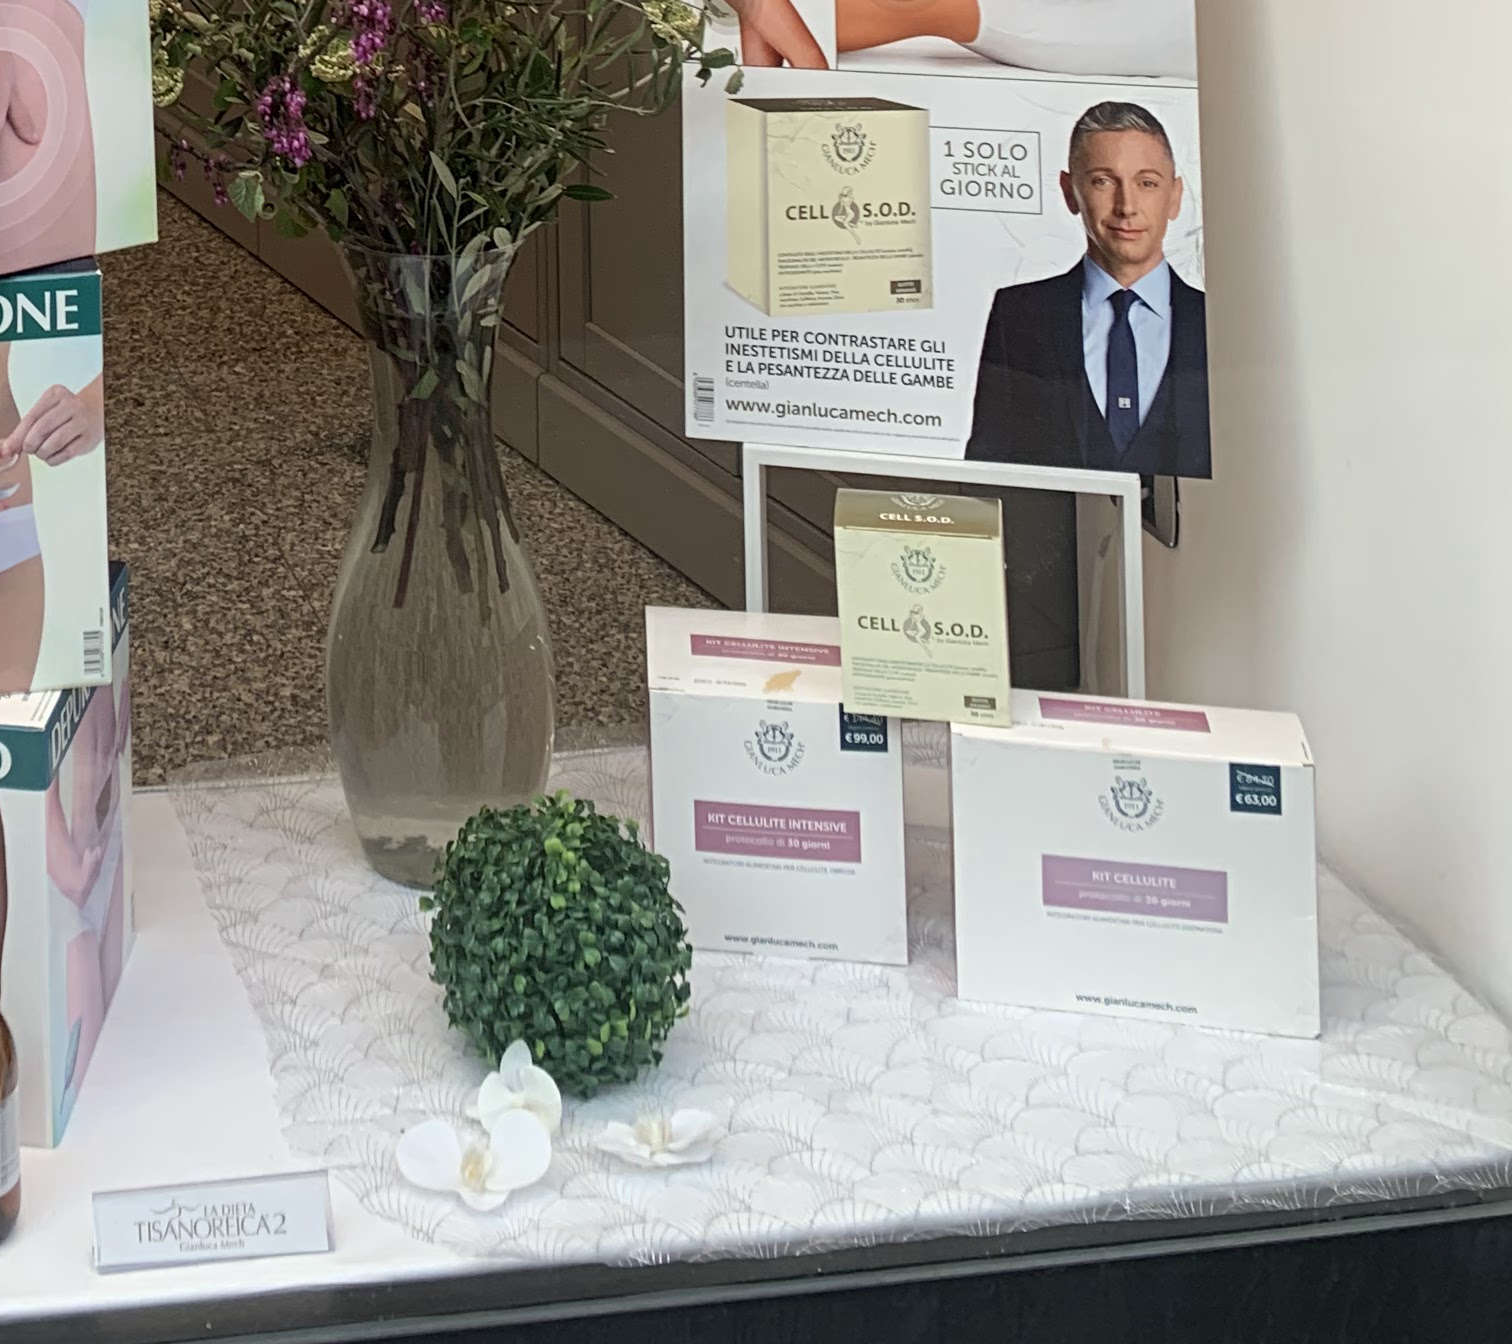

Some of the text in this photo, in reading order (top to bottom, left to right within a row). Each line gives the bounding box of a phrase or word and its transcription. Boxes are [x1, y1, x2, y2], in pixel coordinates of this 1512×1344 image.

[943, 141, 1028, 161] 1 SOLO
[952, 162, 1020, 179] STICK AL
[940, 179, 1034, 200] GIORNO
[786, 202, 916, 221] CELL S.O.D.
[725, 326, 945, 354] UTILE PER CONTRASTARE GLI
[725, 343, 955, 372] INESTETISMI DELLA CELLULITE
[726, 361, 954, 389] E LA PESANTEZZA DELLE GAMBE
[726, 399, 941, 427] www.gianlucamech.com
[858, 615, 989, 639] CELL S.O.D.
[708, 813, 847, 833] KIT CELLULITE INTENSIVE
[134, 1214, 287, 1243] TISANOREICA 2
